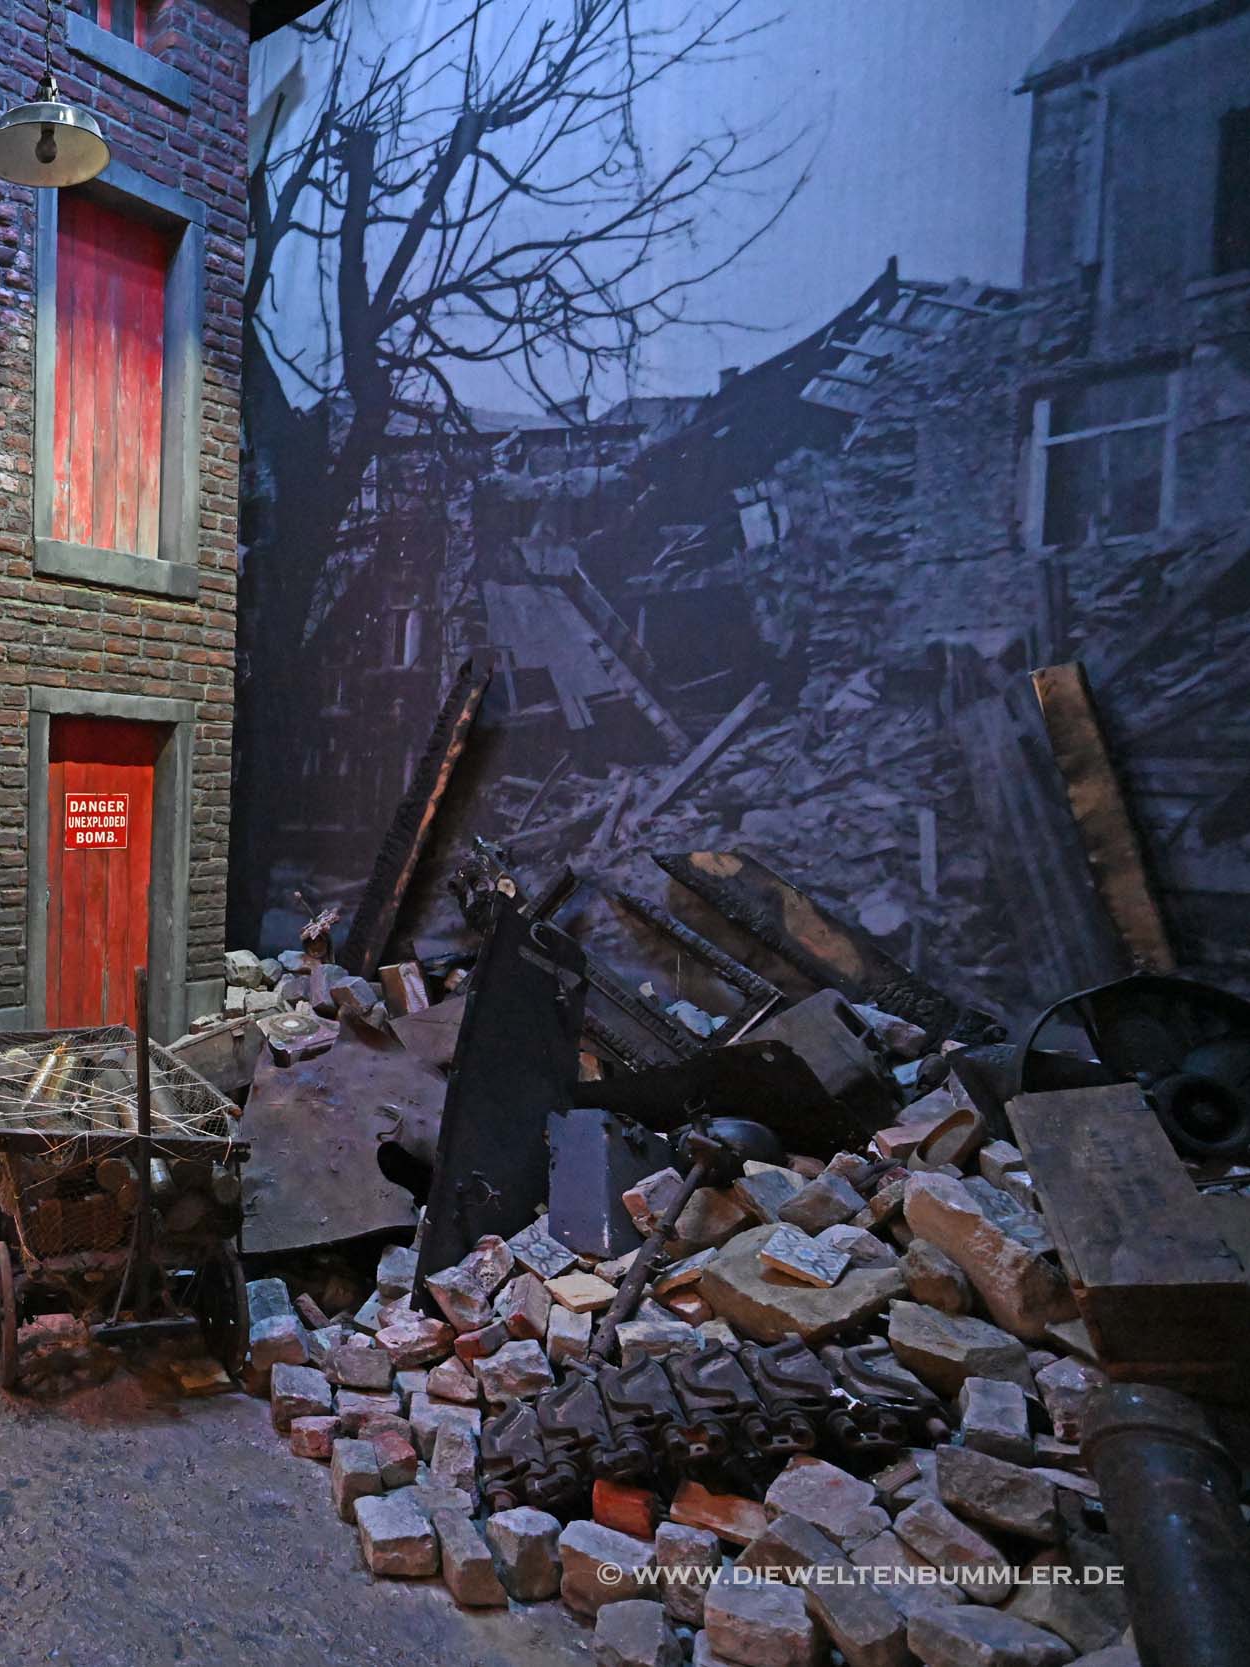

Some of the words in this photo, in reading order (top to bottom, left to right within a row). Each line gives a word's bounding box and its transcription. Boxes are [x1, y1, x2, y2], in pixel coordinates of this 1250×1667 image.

[69, 800, 125, 813] DANGER
[68, 815, 126, 829] UNEXPLODED
[76, 831, 118, 844] BOMB.
